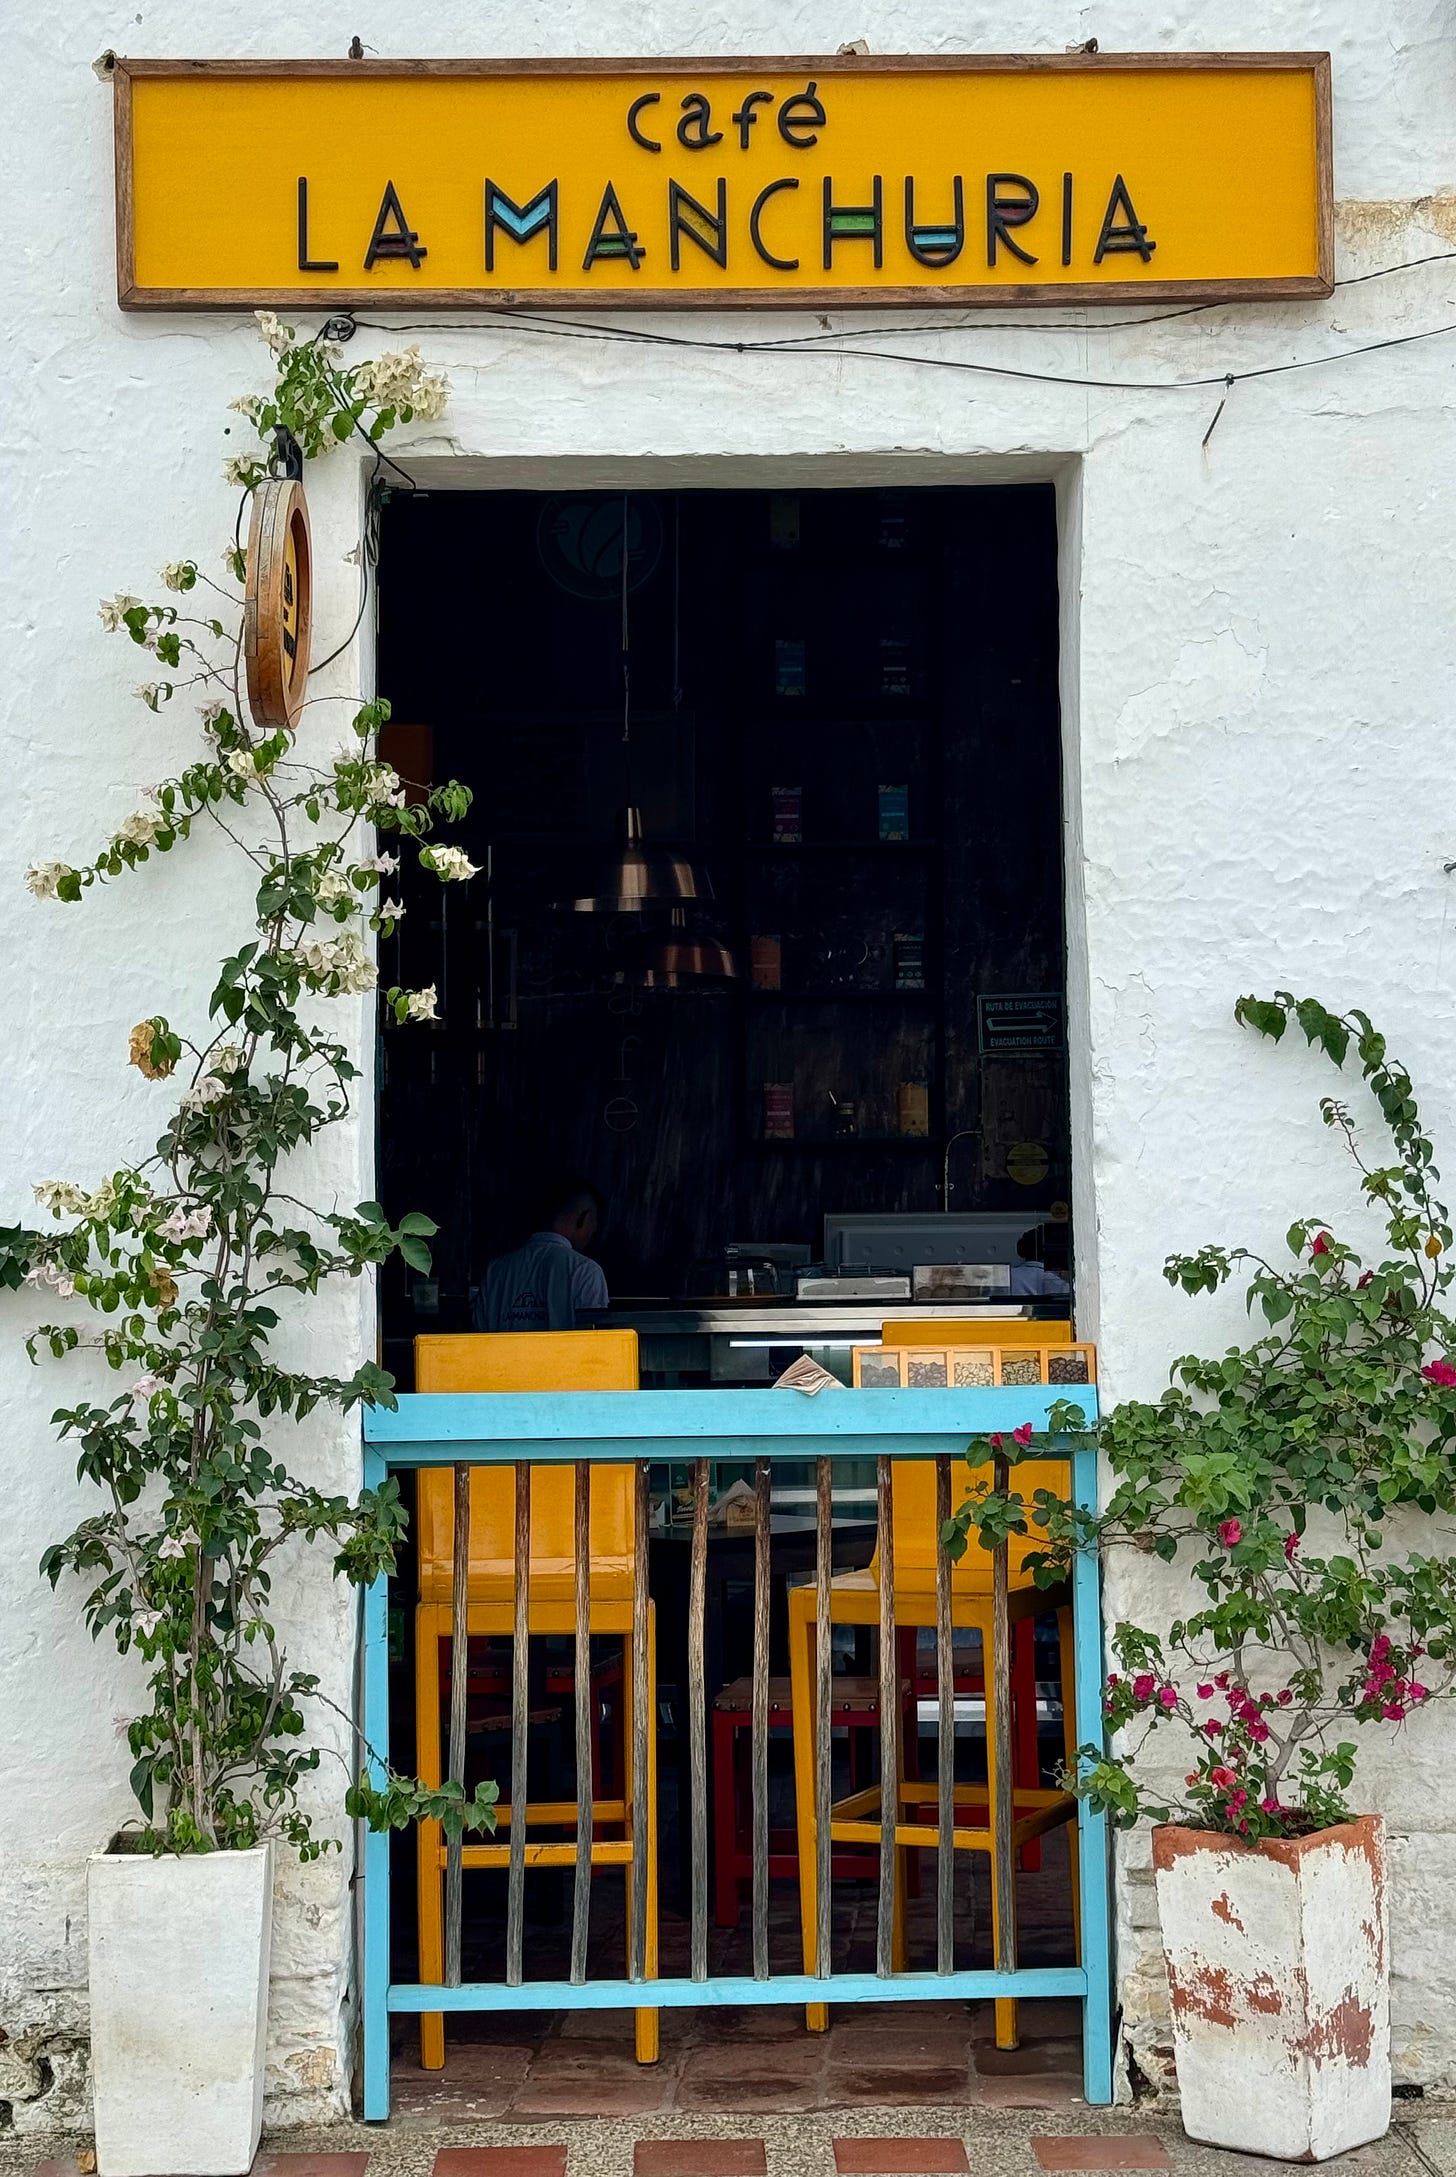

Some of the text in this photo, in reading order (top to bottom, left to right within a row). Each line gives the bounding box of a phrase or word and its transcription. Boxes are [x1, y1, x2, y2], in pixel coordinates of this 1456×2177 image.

[627, 81, 827, 154] café
[298, 173, 1157, 274] LA MANCHURIA
[985, 1001, 1003, 1012] RUTA
[1004, 1001, 1013, 1011] DE
[990, 1035, 1056, 1047] EVACUATION ROUTE
